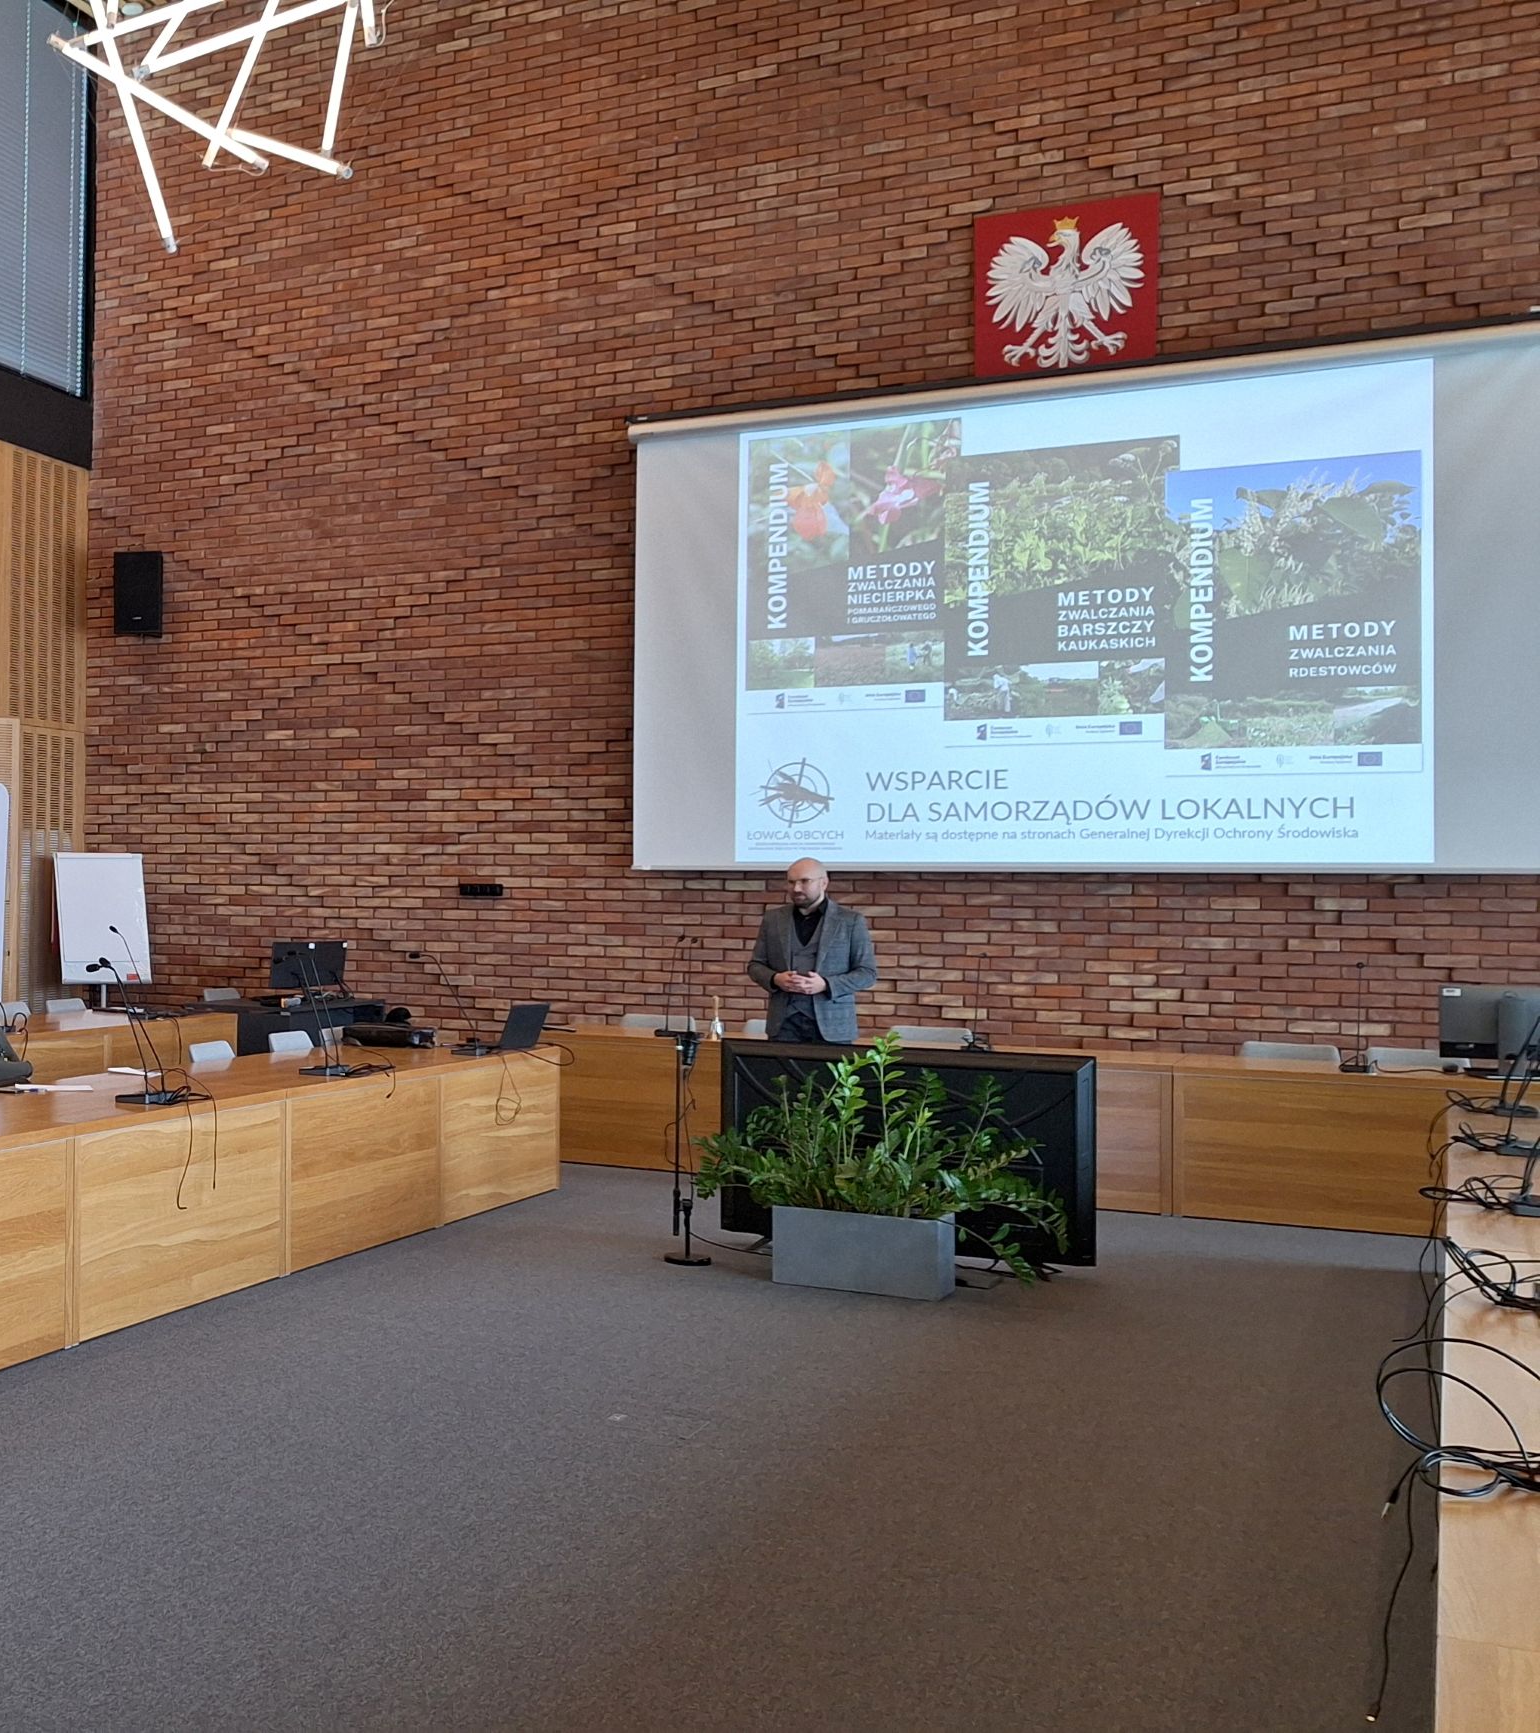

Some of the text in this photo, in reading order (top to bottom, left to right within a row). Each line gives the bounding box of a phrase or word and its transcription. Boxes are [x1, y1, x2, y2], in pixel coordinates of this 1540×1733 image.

[767, 462, 789, 629] KOMPENDIUM
[847, 560, 936, 580] METODY
[967, 480, 990, 657] KOMPENDIUM
[847, 577, 936, 592] ZWALCZANIA
[1189, 498, 1214, 683] KOMPENDIUM
[847, 589, 936, 605] NIECIERPKA
[1057, 586, 1156, 607] METODY
[847, 602, 937, 615] POMARAŃCZOWEGO
[851, 611, 937, 624] GRUCZOŁOWATEGO
[1057, 605, 1156, 621] ZWALCZANIA
[1057, 620, 1156, 638] BARSZCZY
[1288, 620, 1397, 641] METODY
[1057, 636, 1157, 651] KAUKASKICH
[1288, 644, 1397, 660] ZWALCZANIA
[1288, 662, 1397, 678] RDESTOWCÓW
[865, 768, 1009, 791] WSPARCIE
[867, 793, 1355, 825] DLA SAMORZĄDÓW LOKALNYCH
[747, 830, 844, 840] ŁOWCA OBCYCH
[865, 824, 1359, 842] Materiały są dostępne na stronach Generalnej Dyrekcji Ochrony Środowiska
